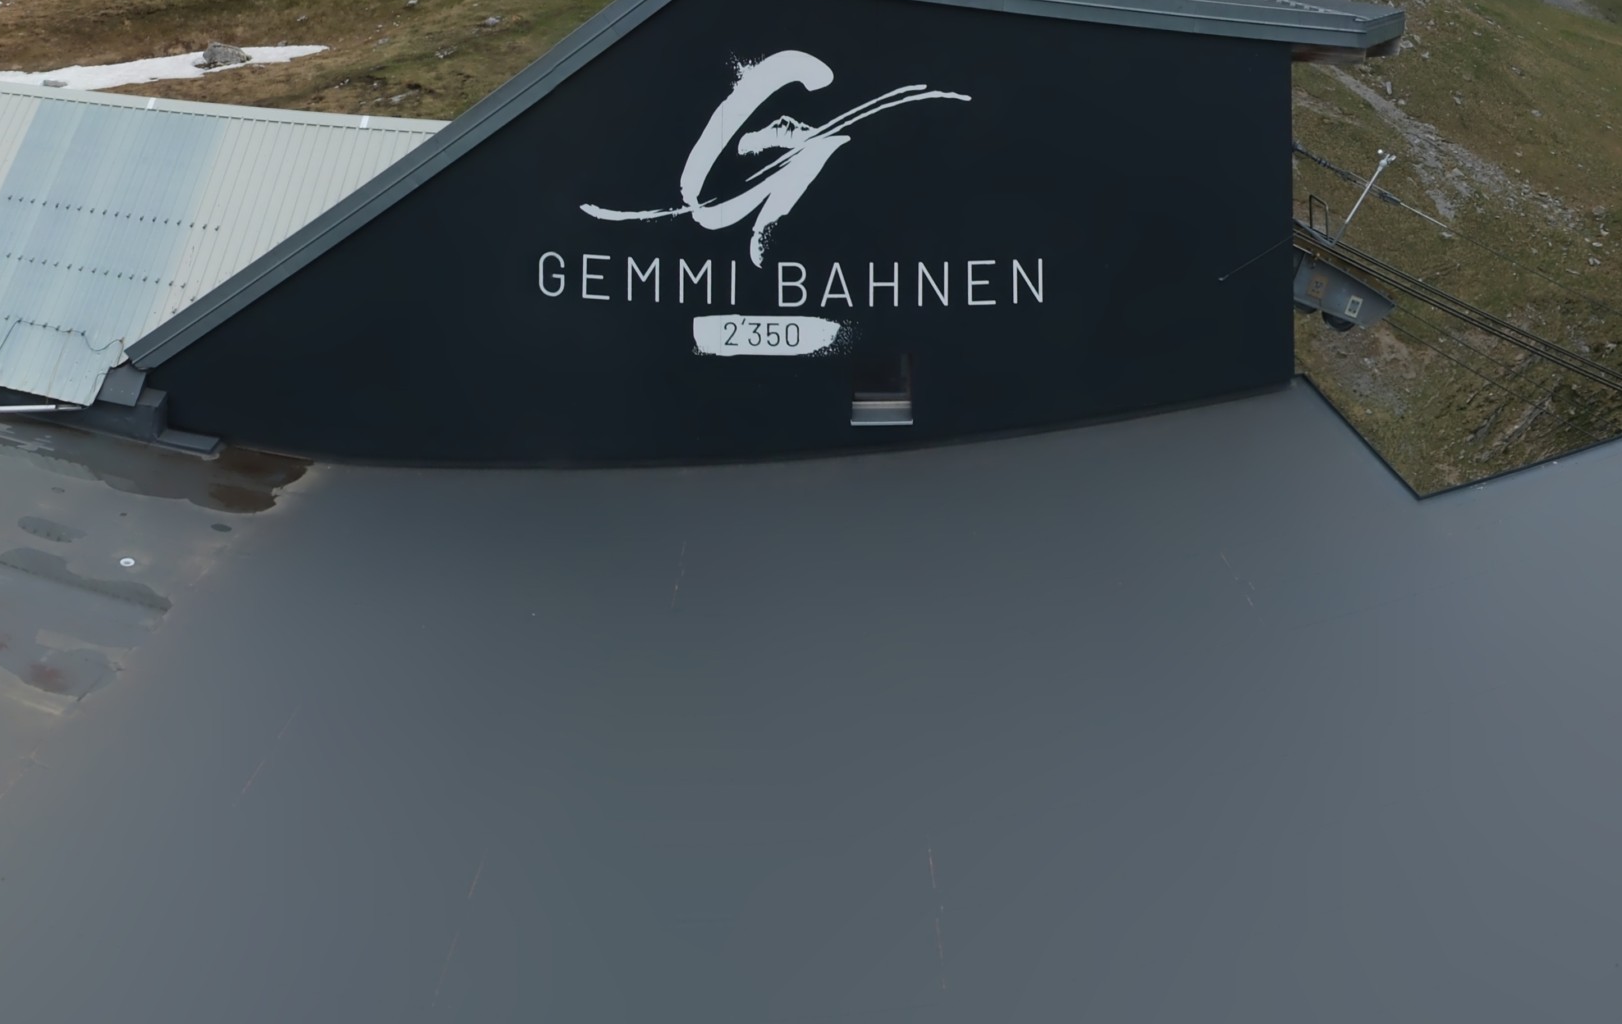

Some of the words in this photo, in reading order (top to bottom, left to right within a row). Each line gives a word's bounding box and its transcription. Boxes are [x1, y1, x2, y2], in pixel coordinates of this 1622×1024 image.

[538, 251, 736, 305] GEMMI
[777, 258, 1044, 308] BAHNEN
[722, 318, 802, 349] 2'350
